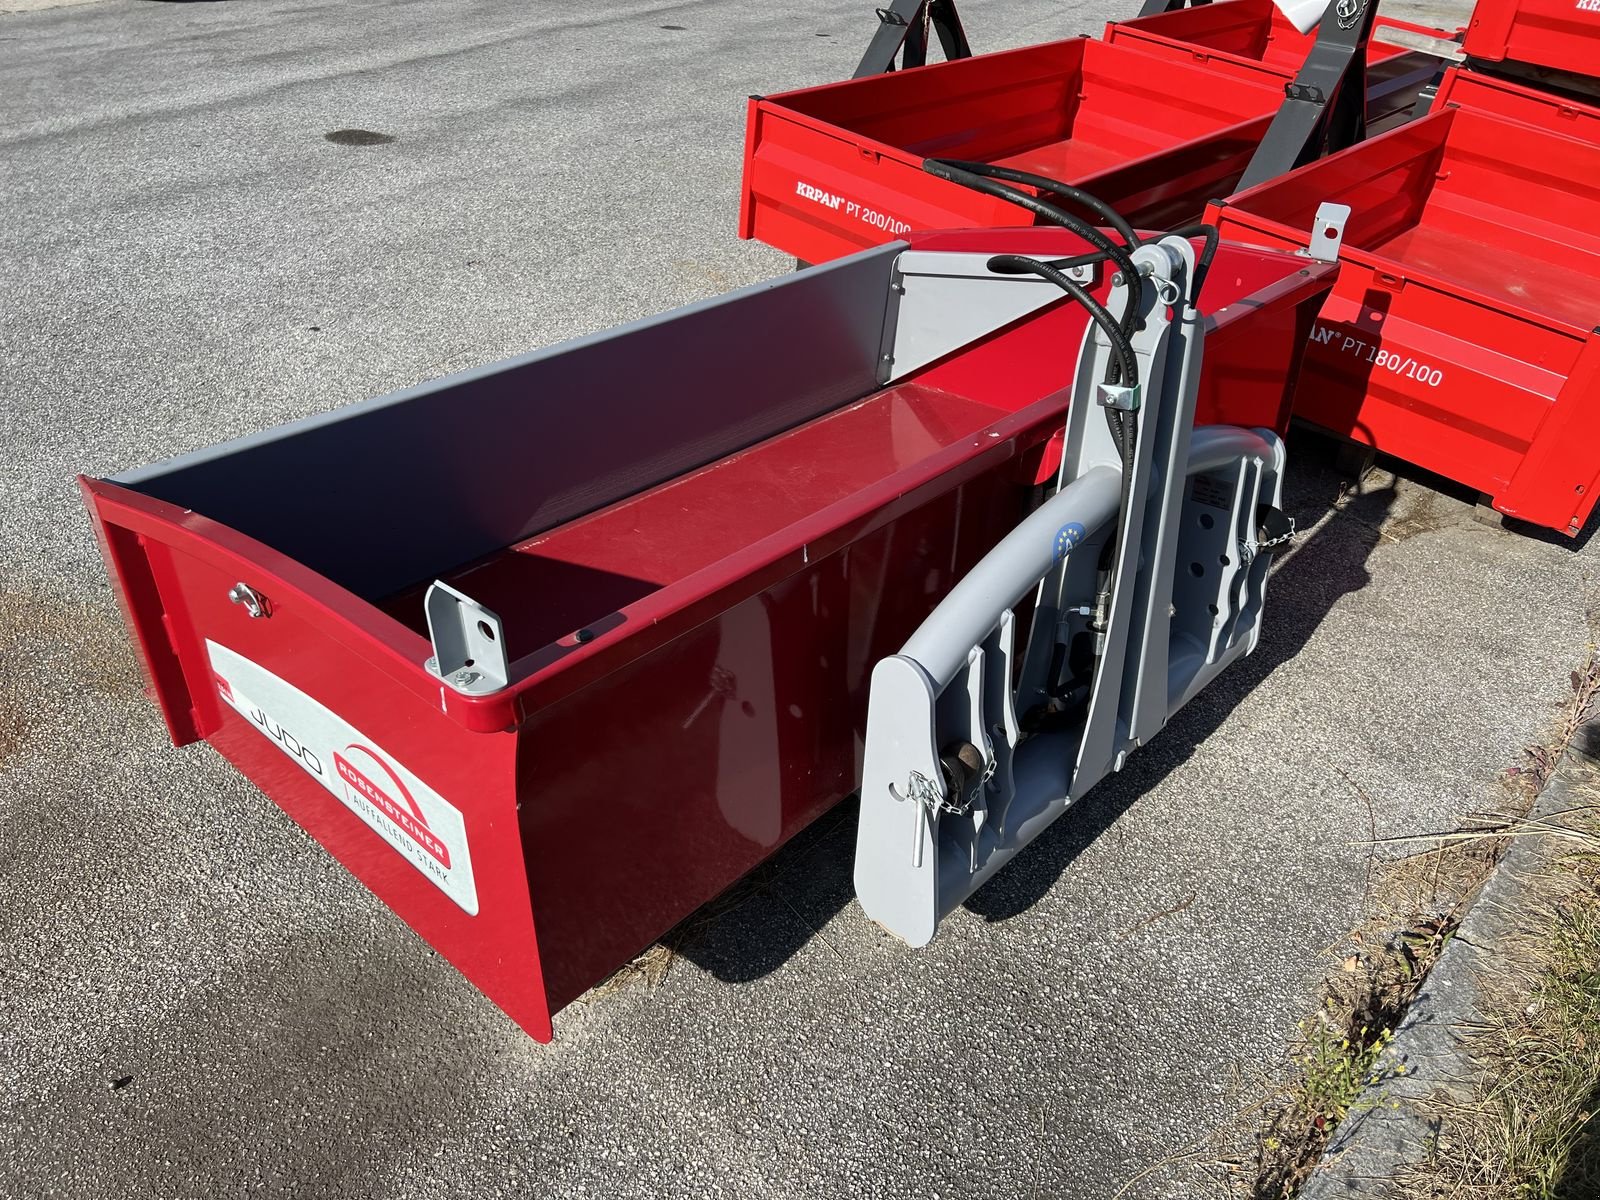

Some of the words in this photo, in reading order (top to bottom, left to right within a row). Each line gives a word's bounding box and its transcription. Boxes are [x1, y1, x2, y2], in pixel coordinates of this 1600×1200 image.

[846, 201, 861, 218] PT
[1341, 337, 1367, 357] PT
[1366, 346, 1443, 387] 180/100
[250, 708, 323, 775] JUDO
[338, 761, 446, 859] ROSENSTEINER
[353, 795, 413, 852] AUFFALLEND
[416, 849, 450, 886] STARK
